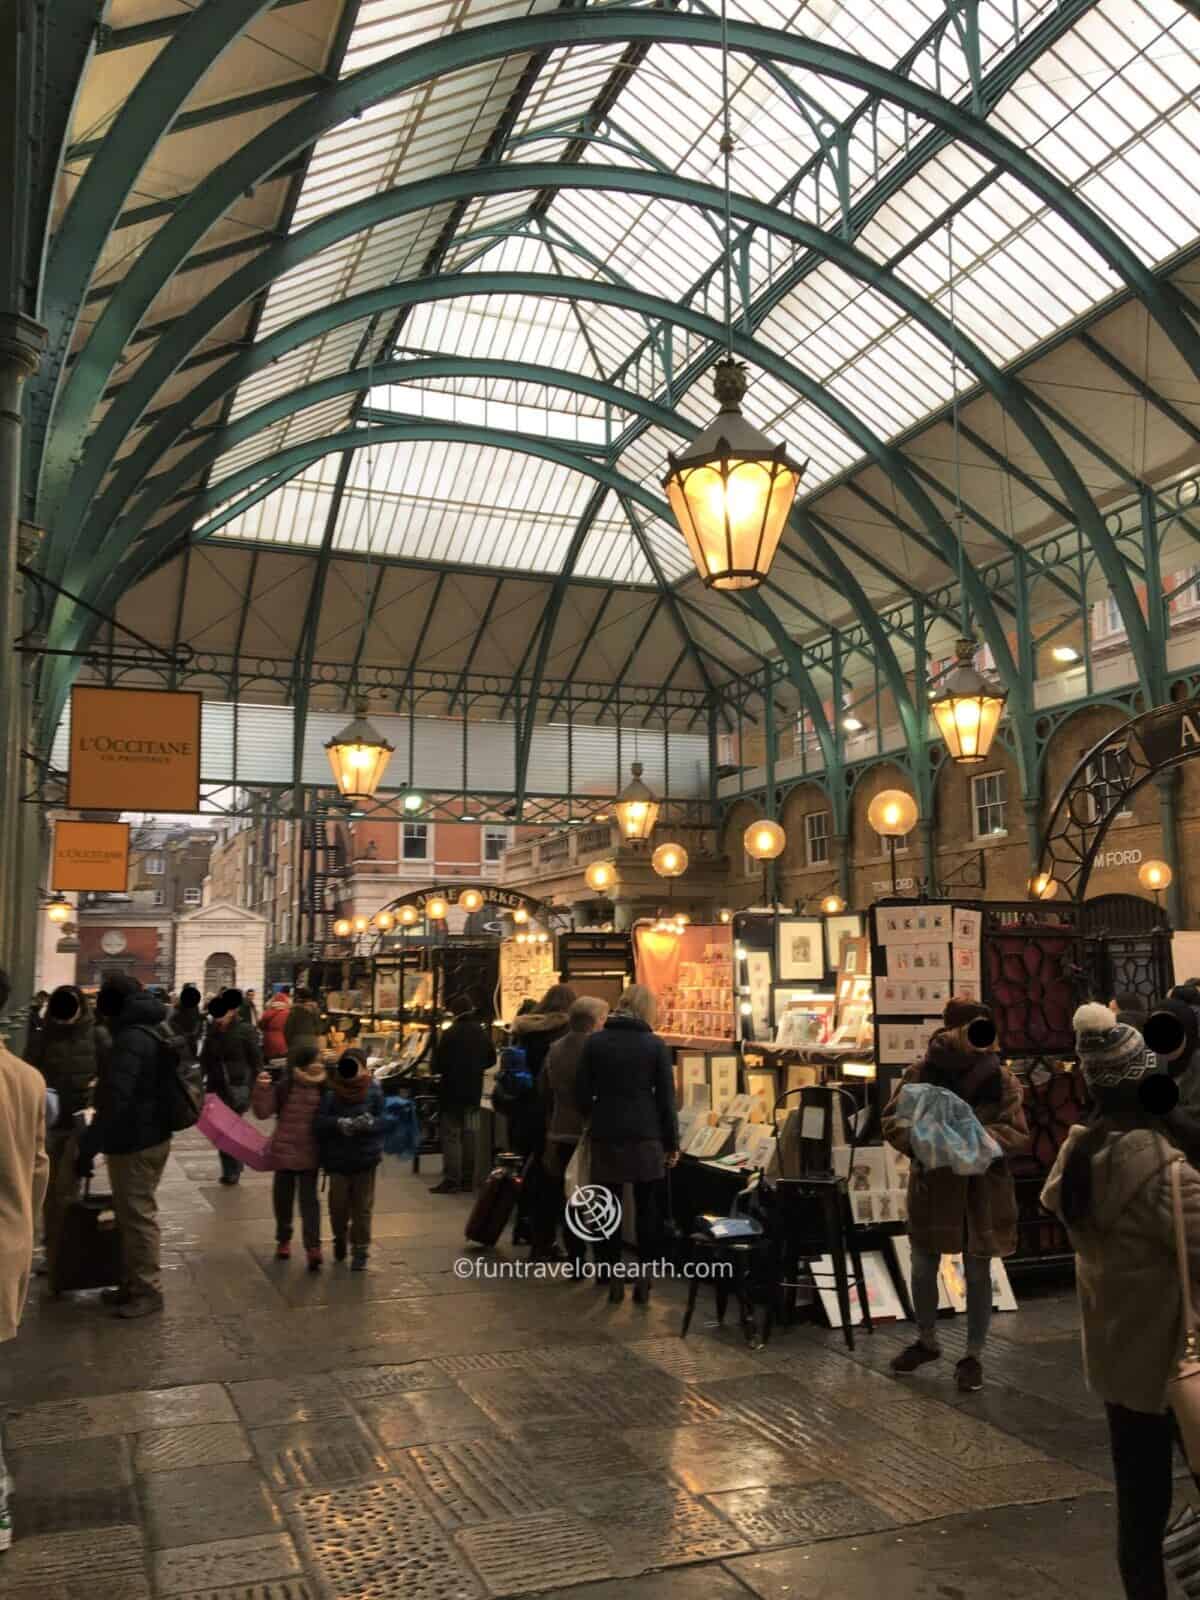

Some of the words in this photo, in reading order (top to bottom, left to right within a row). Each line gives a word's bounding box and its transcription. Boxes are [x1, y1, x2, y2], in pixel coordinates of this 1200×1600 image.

[80, 736, 192, 755] L'OCCITANE
[1105, 848, 1142, 868] FORD
[477, 889, 527, 908] ARKET
